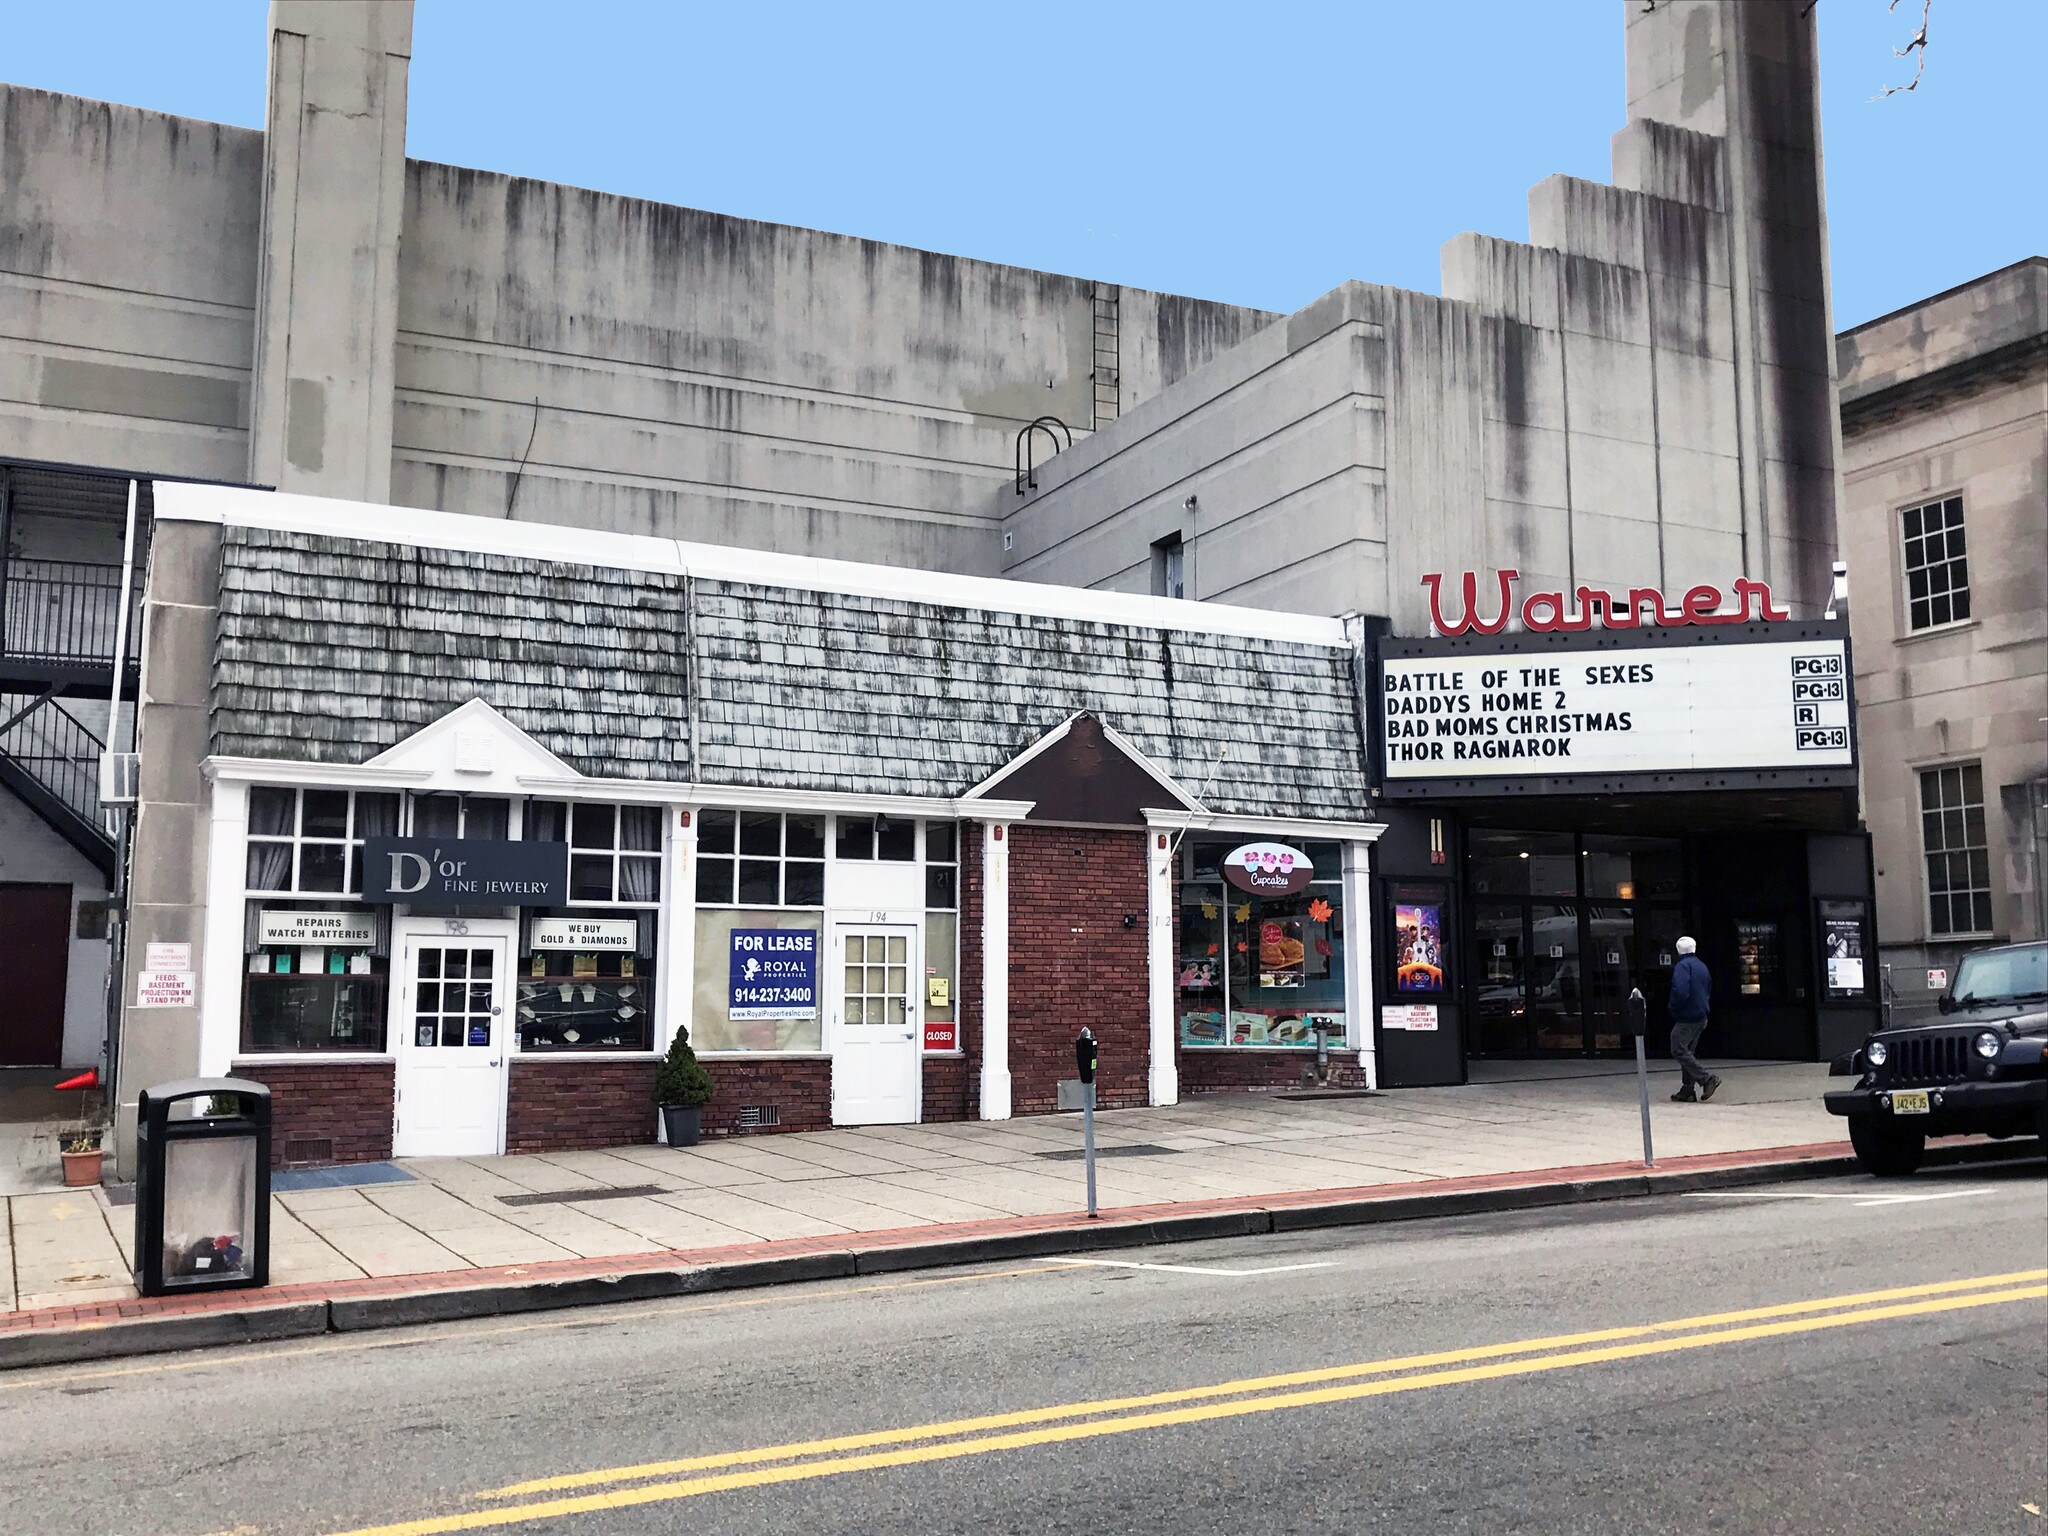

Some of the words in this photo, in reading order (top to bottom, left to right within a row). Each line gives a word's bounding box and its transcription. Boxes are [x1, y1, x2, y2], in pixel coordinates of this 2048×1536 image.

[1421, 570, 1790, 637] Warner
[1384, 672, 1464, 692] BATTLE
[1481, 670, 1508, 689] OF
[1519, 668, 1561, 687] THE
[1585, 664, 1654, 685] SEXES
[1387, 694, 1471, 715] DADDYS
[1482, 692, 1543, 712] HOME
[1555, 691, 1566, 710] 2
[1798, 707, 1813, 722] R
[1388, 719, 1429, 738] BAD
[1436, 717, 1498, 737] MOMS
[1506, 712, 1632, 735] CHRISTMAS
[1388, 742, 1444, 762] THOR
[1453, 737, 1571, 760] RAGNAROK
[385, 848, 467, 893] D'or
[1250, 872, 1289, 887] Cupcakes
[444, 880, 478, 892] FINE
[485, 881, 549, 895] JEWELRY
[296, 918, 342, 928] REPAIRS
[869, 912, 887, 923] 194
[267, 929, 305, 938] WATCH
[312, 929, 369, 939] BATTERIES
[445, 919, 469, 936] 196
[568, 924, 582, 933] WE
[583, 925, 602, 933] BUY
[541, 935, 564, 944] GOLD
[569, 935, 575, 944] &
[581, 936, 628, 945] DIAMONDS
[734, 936, 764, 951] FOR
[767, 936, 813, 951] LEASE
[764, 961, 807, 972] ROYAL
[735, 987, 812, 1002] 914-237-3400
[926, 1031, 953, 1042] CLOSED
